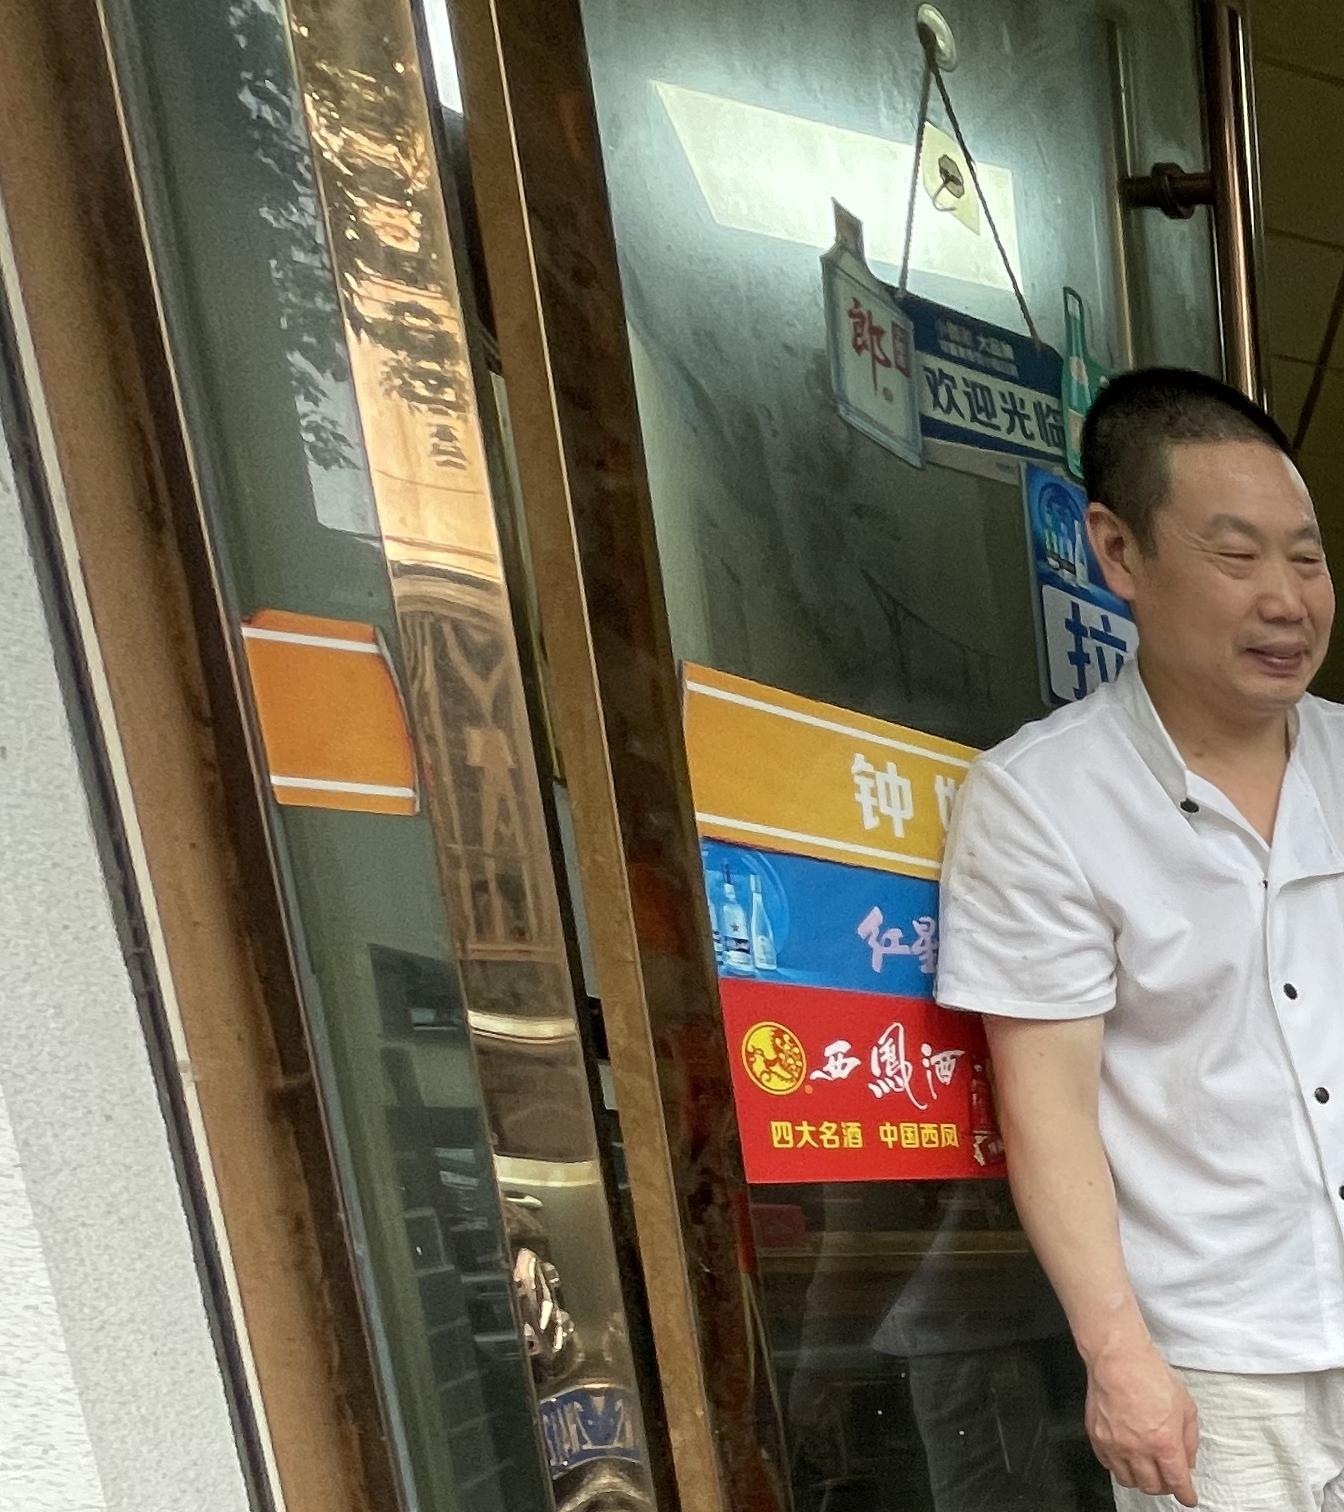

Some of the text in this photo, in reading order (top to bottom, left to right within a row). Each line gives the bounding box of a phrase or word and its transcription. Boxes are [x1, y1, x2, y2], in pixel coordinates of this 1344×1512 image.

[923, 366, 1065, 448] 欢迎光临
[770, 1120, 960, 1150] 四大名酒 中国西凤
